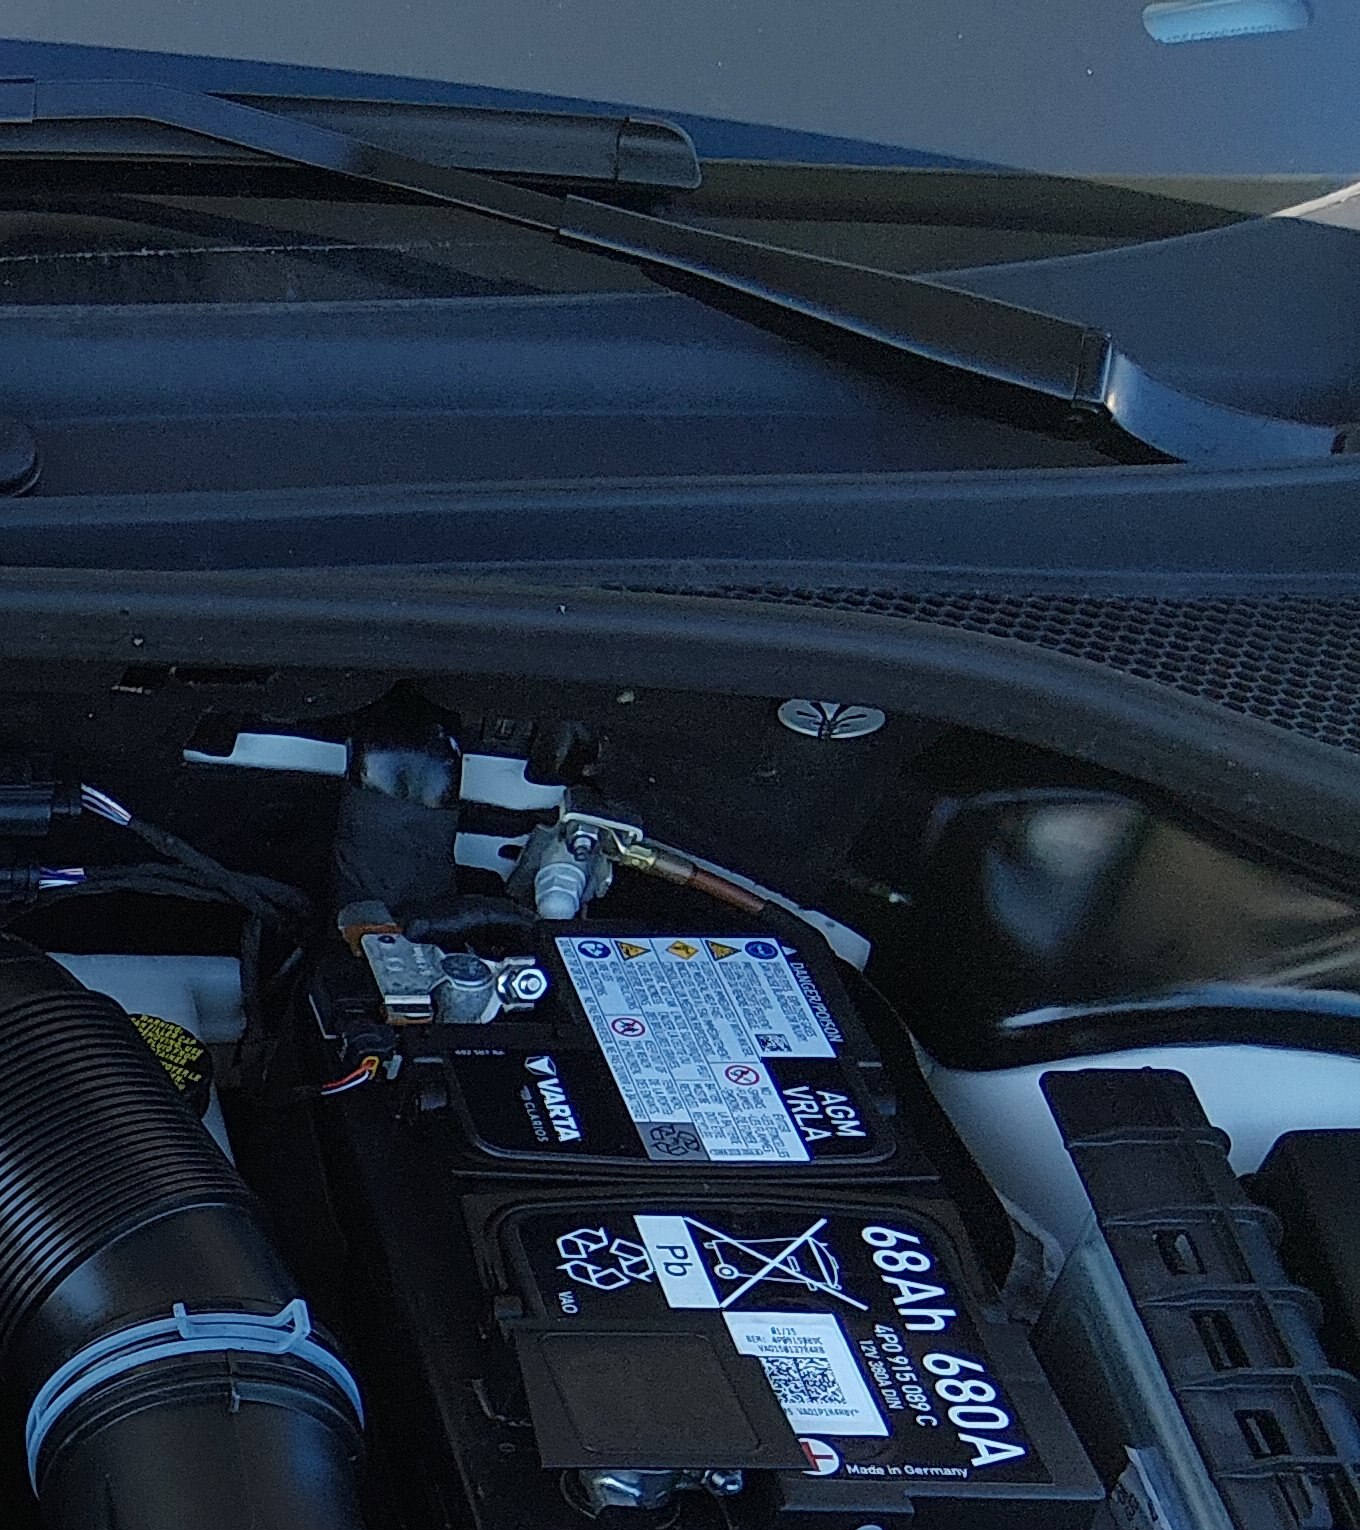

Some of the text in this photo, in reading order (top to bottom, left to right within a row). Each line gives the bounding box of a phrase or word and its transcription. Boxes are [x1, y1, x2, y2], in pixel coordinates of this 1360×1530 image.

[789, 962, 844, 1042] DANGER/POISON
[524, 1101, 550, 1143] CLARIOS
[537, 1077, 582, 1143] VARTA
[778, 1085, 835, 1141] VRLA
[814, 1090, 867, 1136] AGM
[656, 1244, 690, 1278] Pb
[858, 1339, 904, 1411] 12V 380A DIN
[860, 1224, 1026, 1468] 68Ah 680A
[873, 1323, 938, 1428] 4P0 915 089 C
[845, 1463, 969, 1479] Made in Germany
